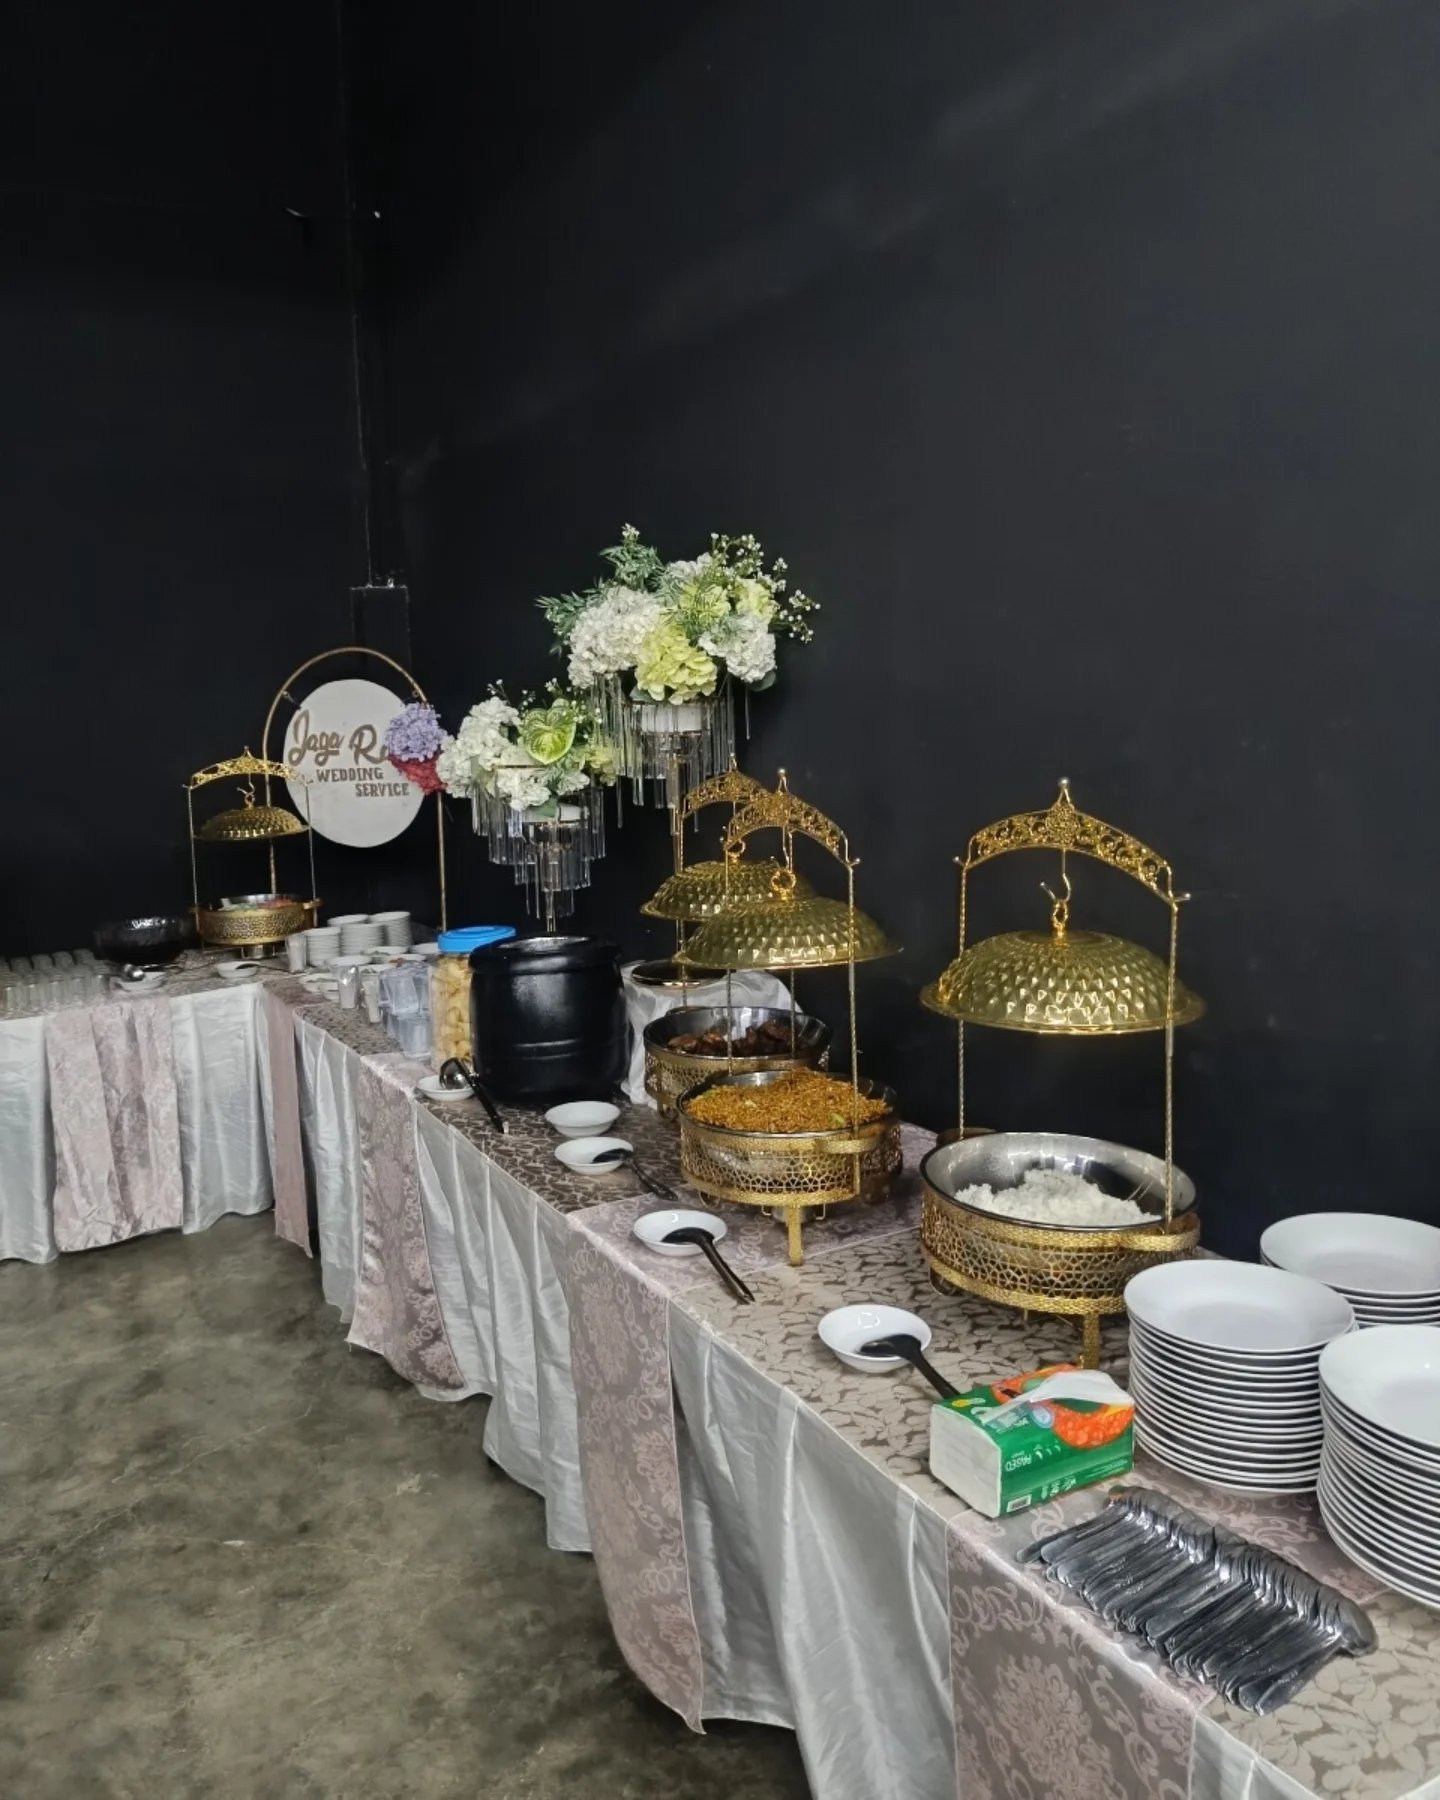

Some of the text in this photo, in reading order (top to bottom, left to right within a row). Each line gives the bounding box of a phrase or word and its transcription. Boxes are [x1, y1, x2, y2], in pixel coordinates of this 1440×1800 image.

[288, 709, 345, 767] Jaga
[316, 767, 384, 783] WEDDING
[355, 782, 410, 798] SERVICE
